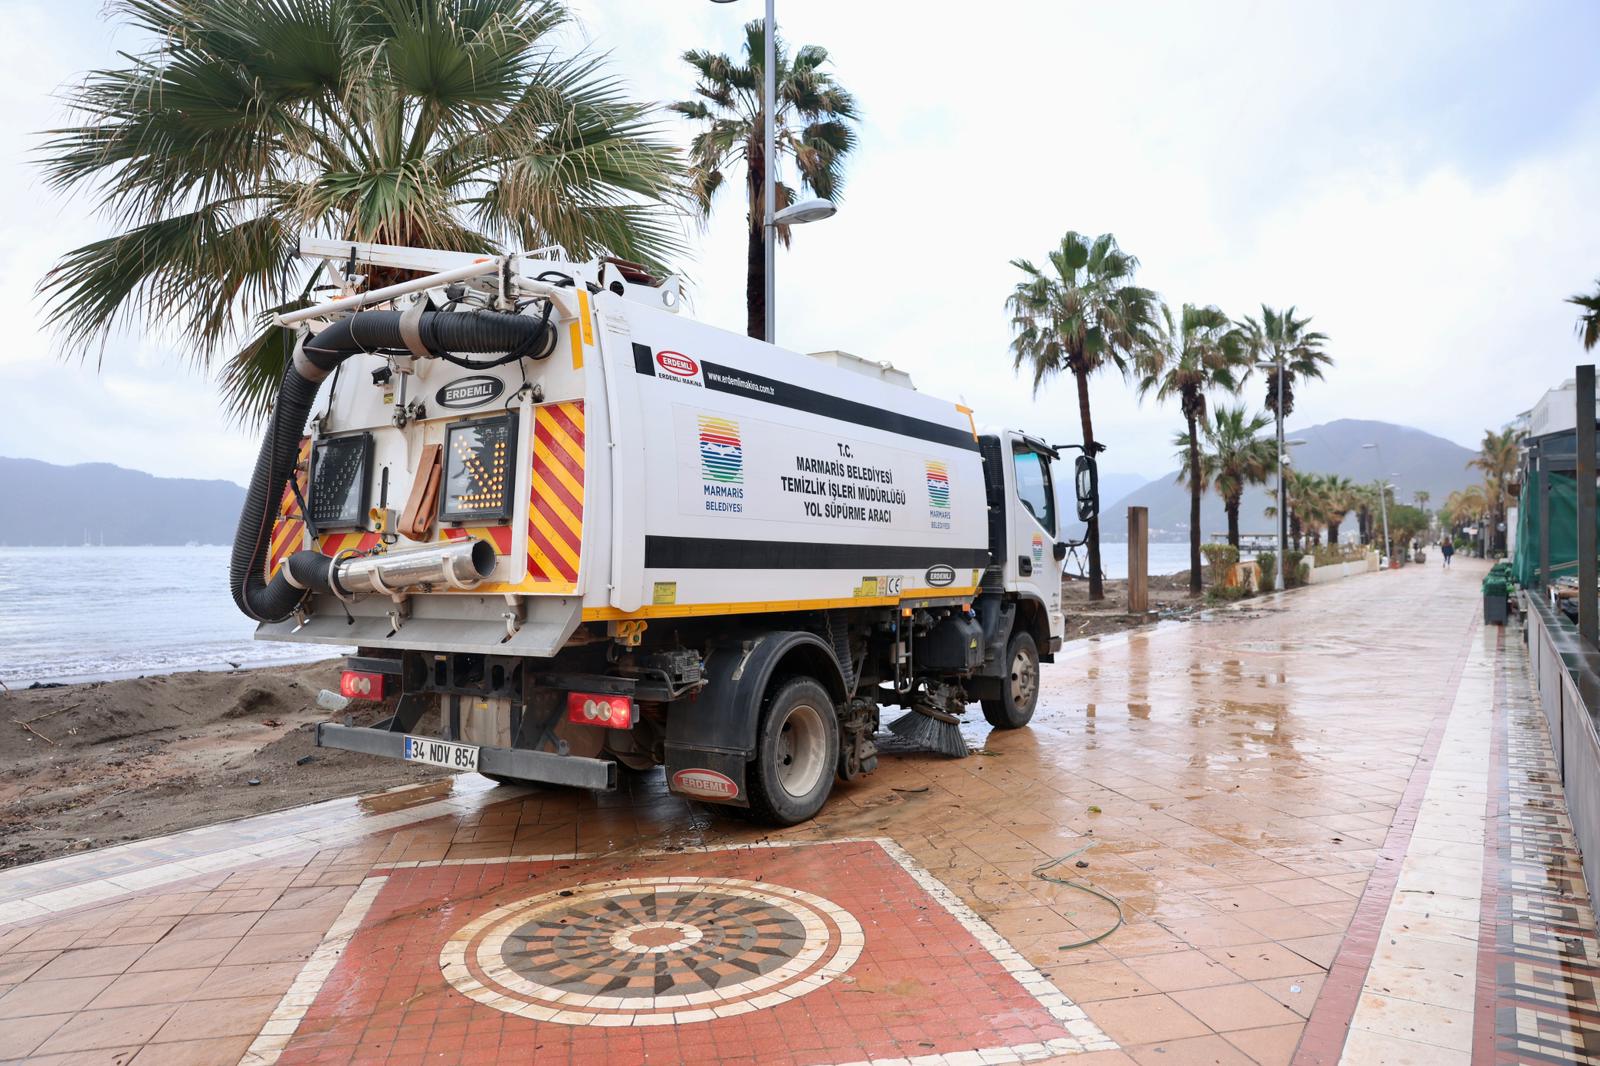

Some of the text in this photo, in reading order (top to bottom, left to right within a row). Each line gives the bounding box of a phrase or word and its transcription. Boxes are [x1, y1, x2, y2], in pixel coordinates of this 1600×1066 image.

[707, 372, 775, 395] www.erdemlimakina.com.tr
[837, 443, 854, 459] T.C.
[796, 456, 893, 484] MARMARİS BELEDİYESİ
[780, 476, 906, 505] TEMİZLİK İŞLERİ MÜDÜRLÜĞÜ
[804, 501, 892, 523] YOL SÜPÜRME ARACI
[889, 578, 902, 593] CE
[413, 741, 475, 768] 34 NDV 854
